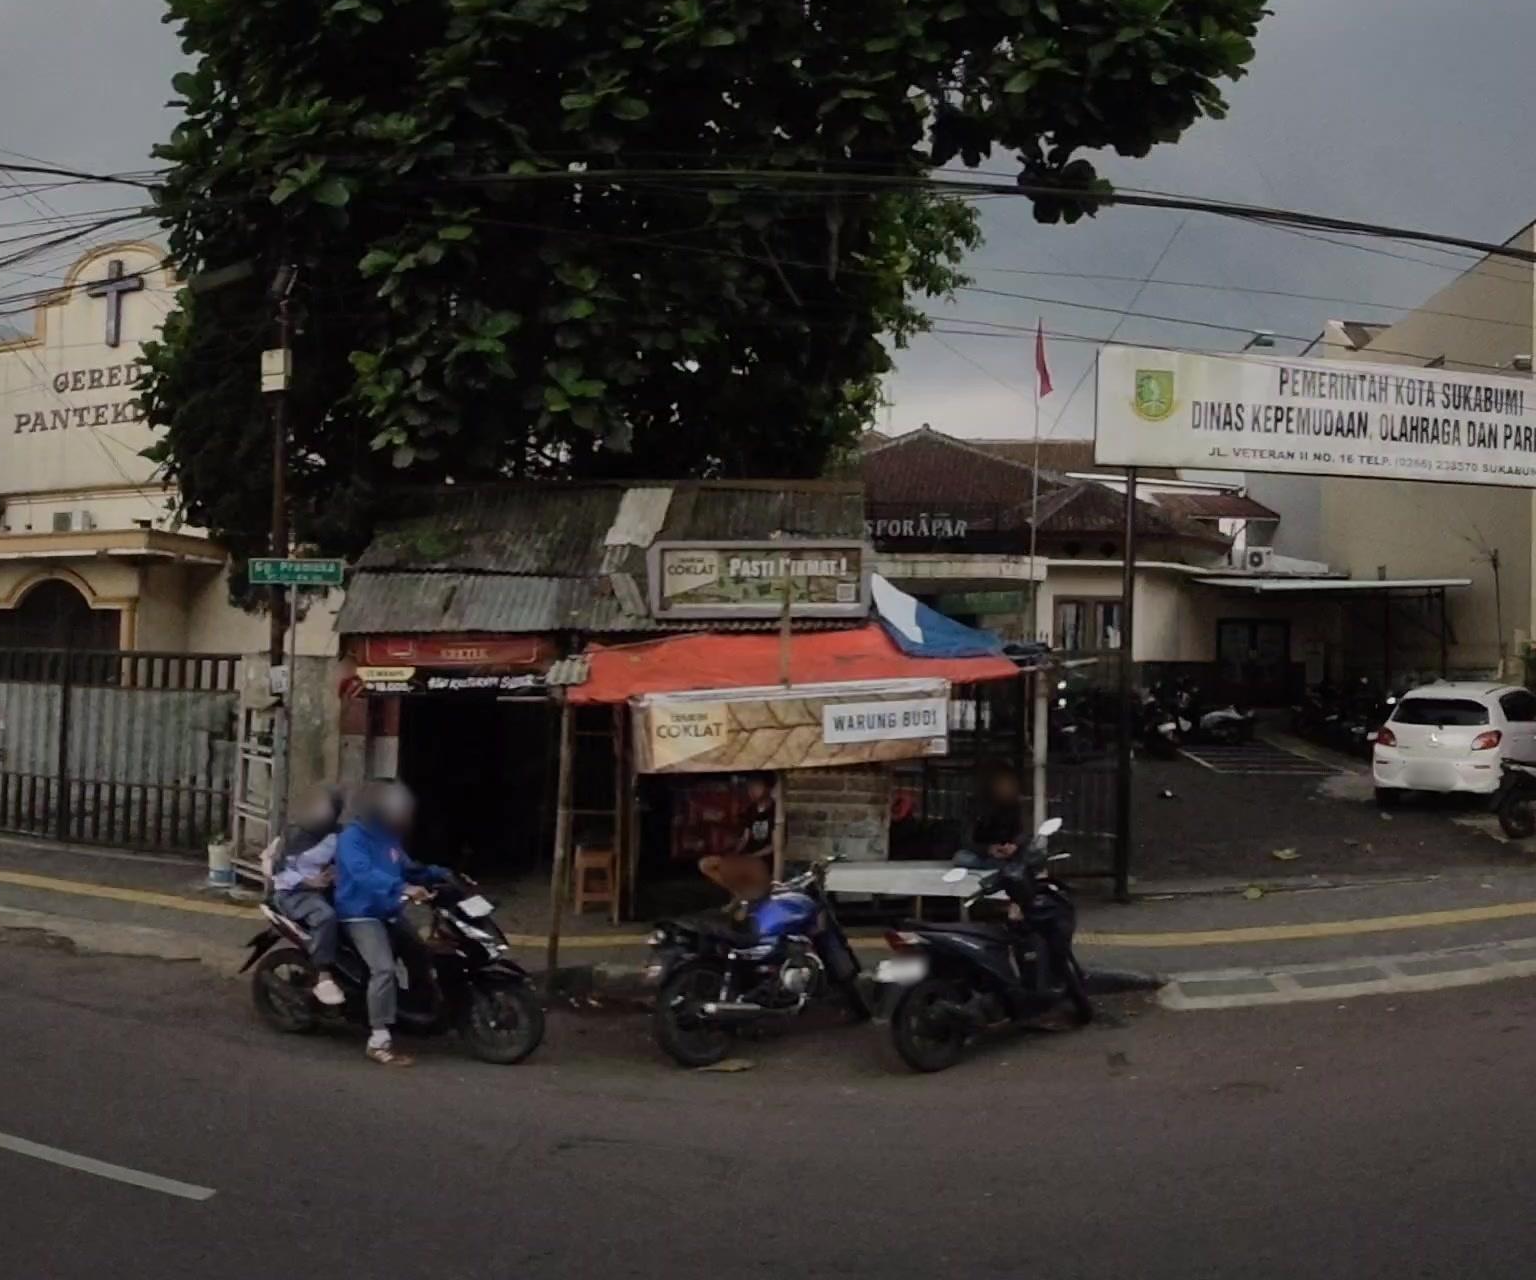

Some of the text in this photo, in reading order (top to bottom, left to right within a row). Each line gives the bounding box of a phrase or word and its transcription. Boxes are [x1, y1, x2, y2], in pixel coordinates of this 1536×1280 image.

[1279, 367, 1524, 417] PEMERINTAH KOTA SUKABUMI
[14, 401, 145, 434] PANTEK
[1191, 400, 1245, 432] DINAS
[1251, 405, 1373, 439] KEPEMUDAAN,
[1380, 413, 1462, 447] OLAHRAGA
[1467, 420, 1498, 449] DAN
[1233, 447, 1295, 460] VETERAN
[1313, 452, 1335, 464] NO.
[1358, 455, 1392, 466] TELP.
[667, 563, 715, 577] COKLAT
[729, 558, 775, 578] PASTI
[656, 722, 723, 739] COKLAT
[834, 714, 897, 733] WARUNG
